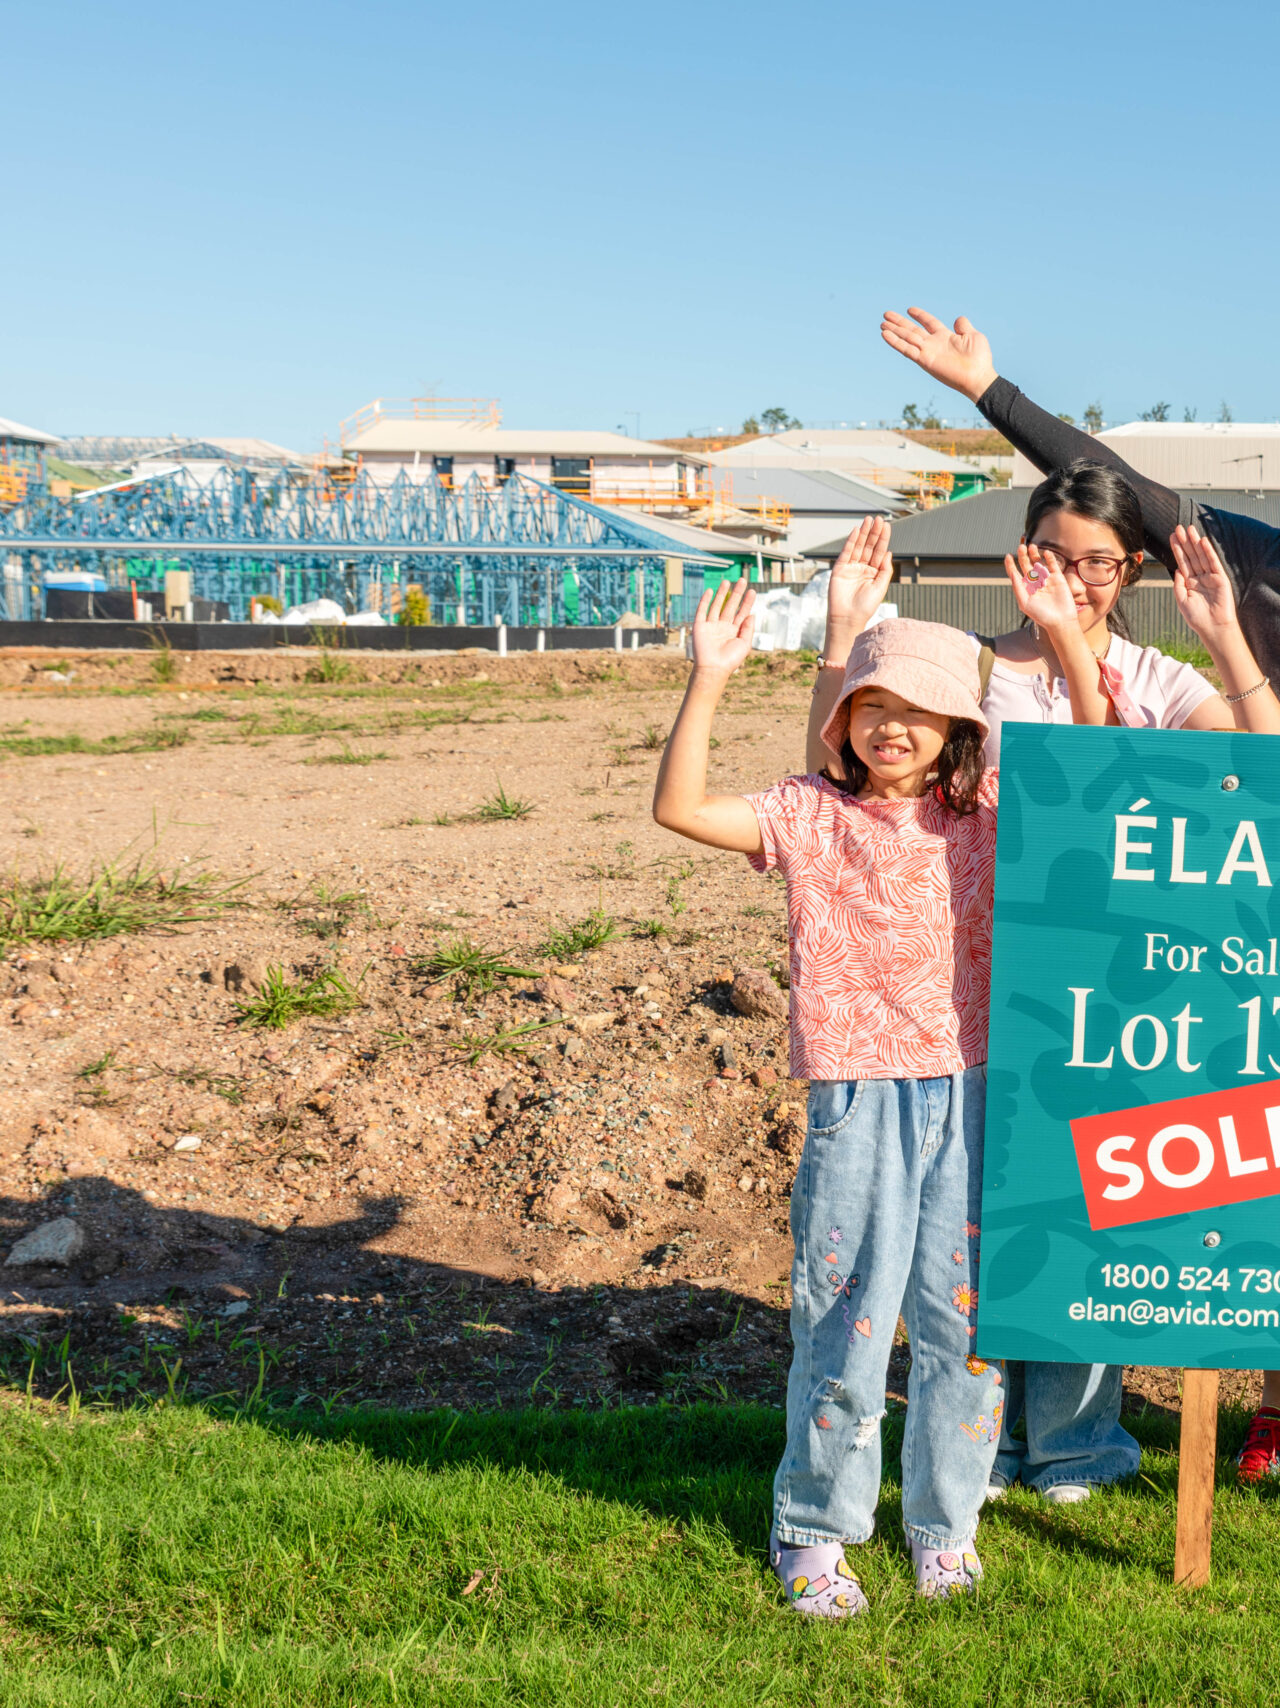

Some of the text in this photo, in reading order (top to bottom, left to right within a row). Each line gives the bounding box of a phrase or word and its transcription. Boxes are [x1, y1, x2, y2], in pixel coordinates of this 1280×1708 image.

[1143, 932, 1208, 973] For
[1064, 987, 1203, 1073] Lot
[1101, 1263, 1170, 1290] 1800
[1177, 1266, 1231, 1292] 524
